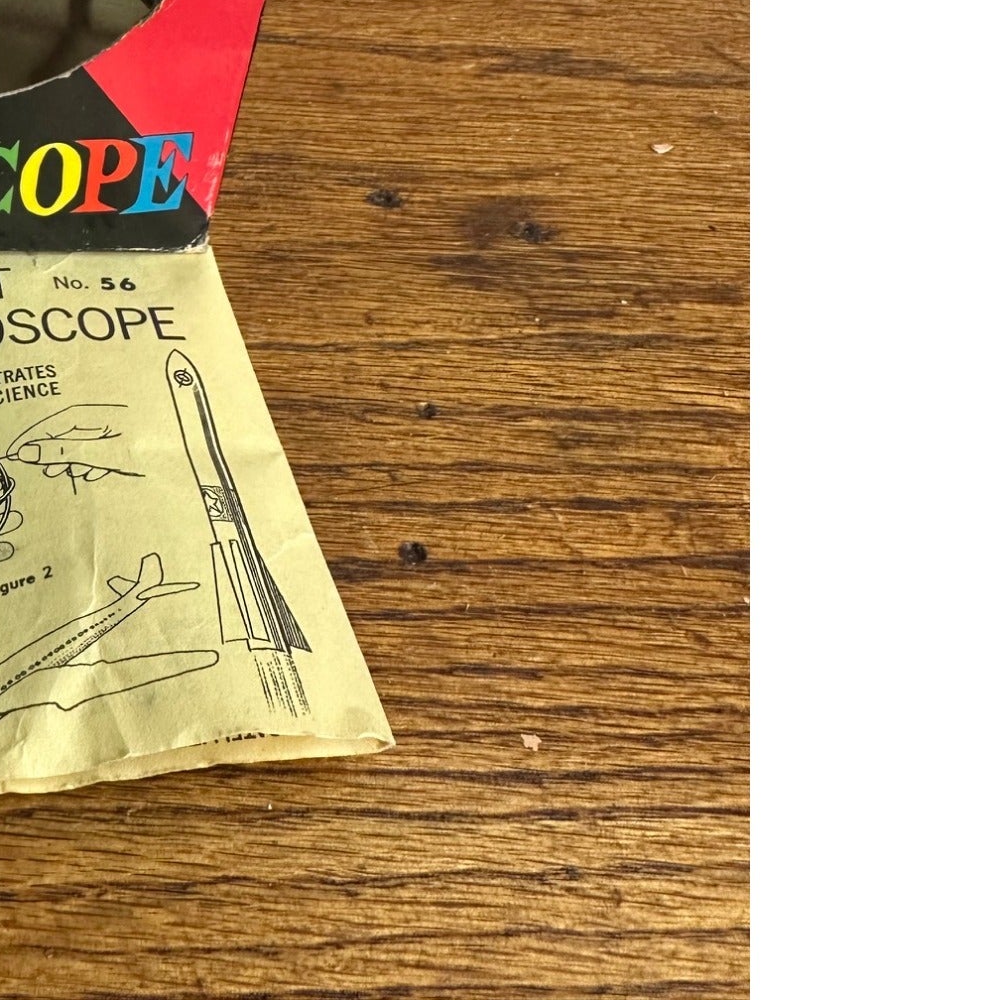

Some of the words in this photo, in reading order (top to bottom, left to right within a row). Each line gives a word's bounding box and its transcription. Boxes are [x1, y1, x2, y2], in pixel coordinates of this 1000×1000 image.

[52, 275, 90, 291] No.
[100, 276, 137, 291] 56
[42, 565, 54, 579] 2
